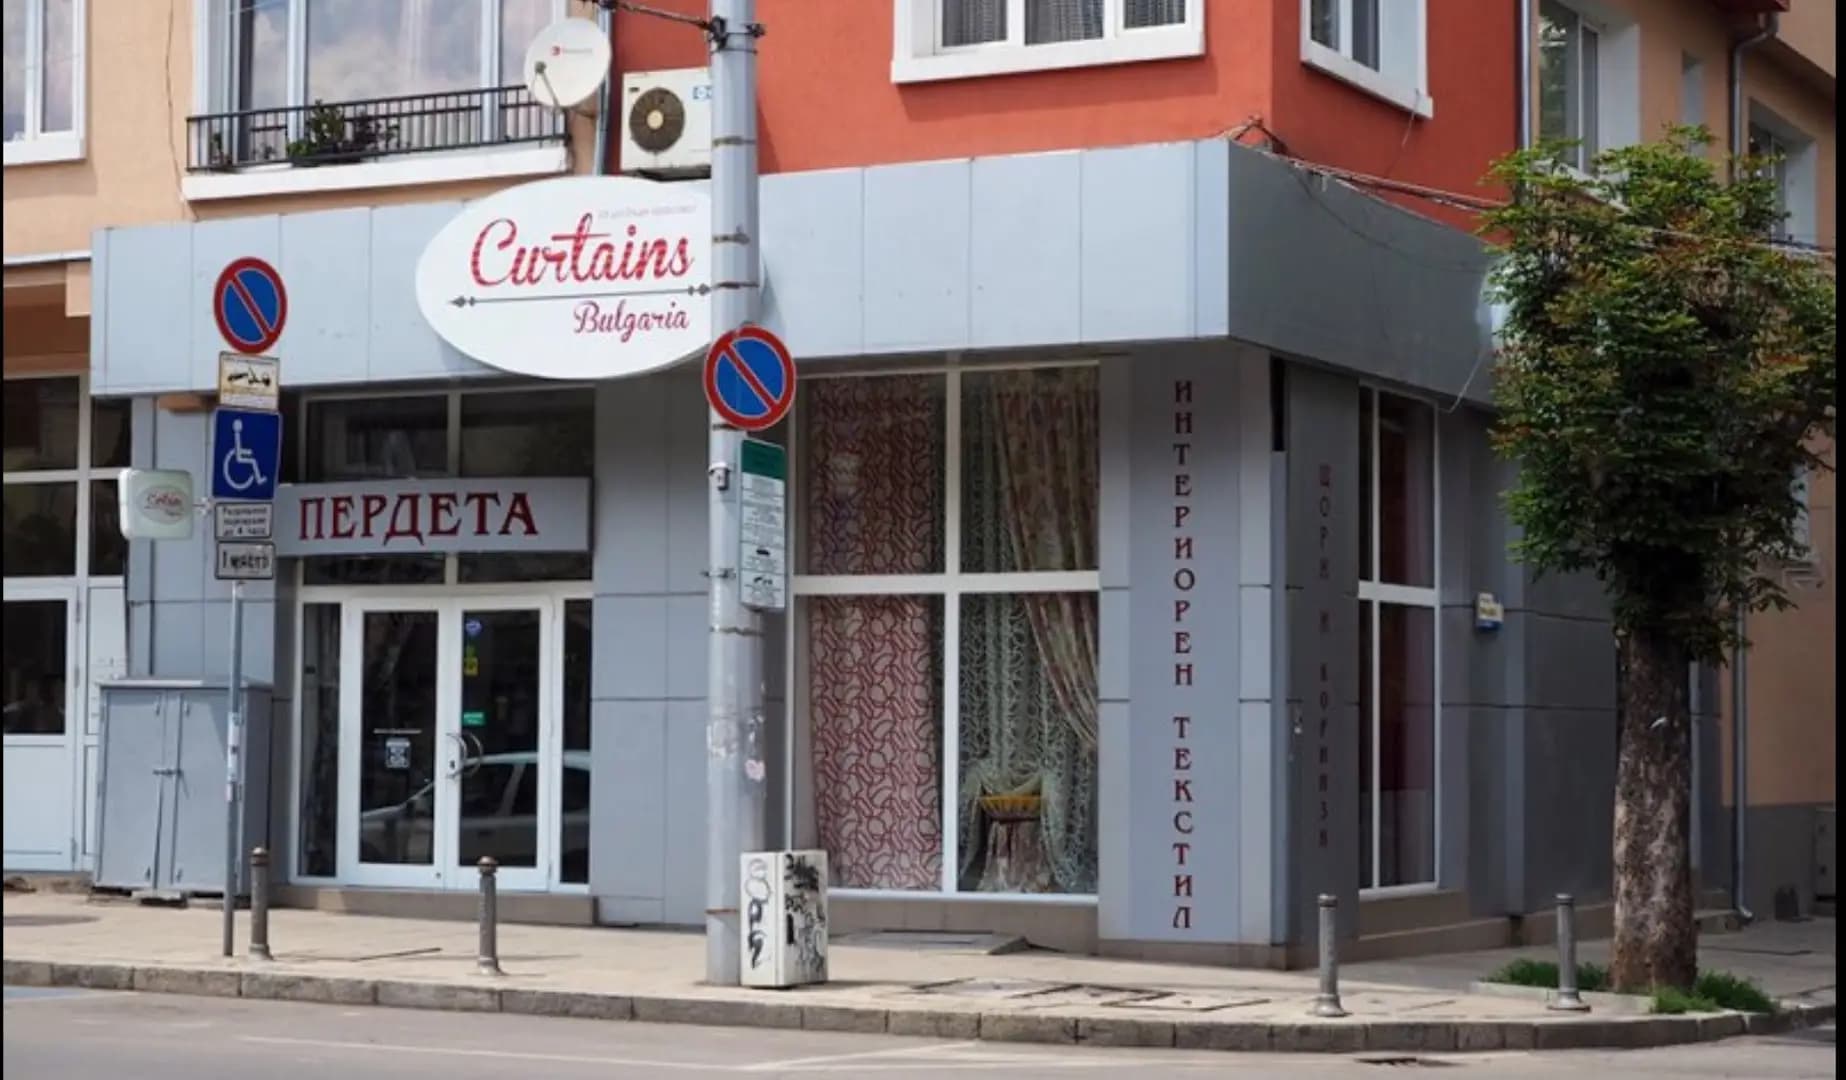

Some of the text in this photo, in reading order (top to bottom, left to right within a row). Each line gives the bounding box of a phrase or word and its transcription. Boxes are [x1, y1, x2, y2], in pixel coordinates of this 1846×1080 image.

[470, 212, 694, 287] Curtains
[573, 300, 690, 343] Bulgaria
[298, 492, 539, 546] ПЕРДЕТА
[1172, 380, 1196, 929] ИНТЕРИОРЕН ТЕКСТИЛ
